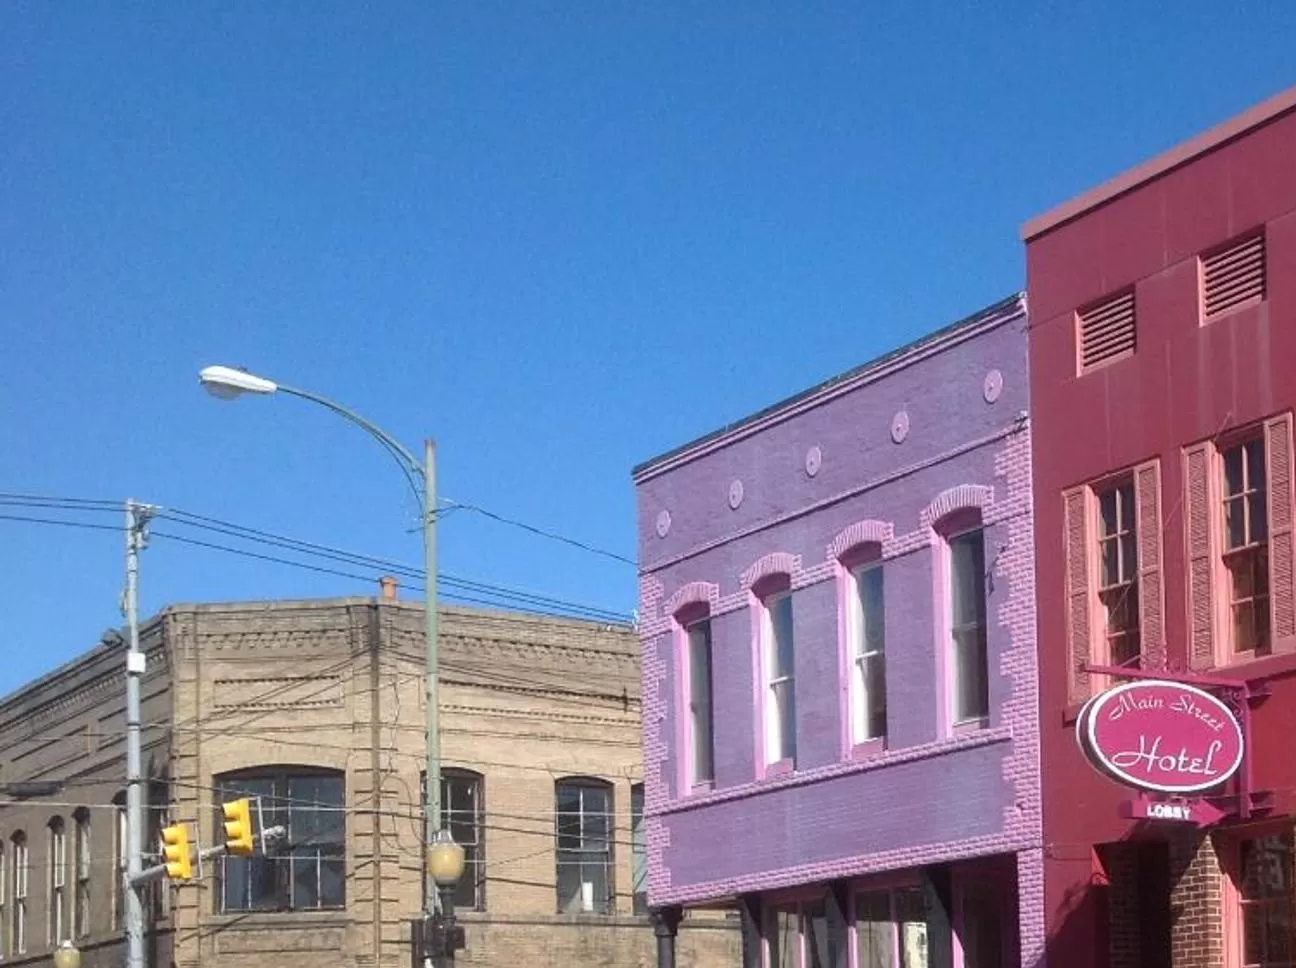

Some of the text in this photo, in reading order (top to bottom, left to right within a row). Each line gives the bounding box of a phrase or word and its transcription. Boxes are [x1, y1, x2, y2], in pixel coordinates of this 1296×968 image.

[1109, 691, 1226, 732] Main Street
[1112, 735, 1223, 775] Hotel
[1147, 804, 1192, 820] LOBBY
